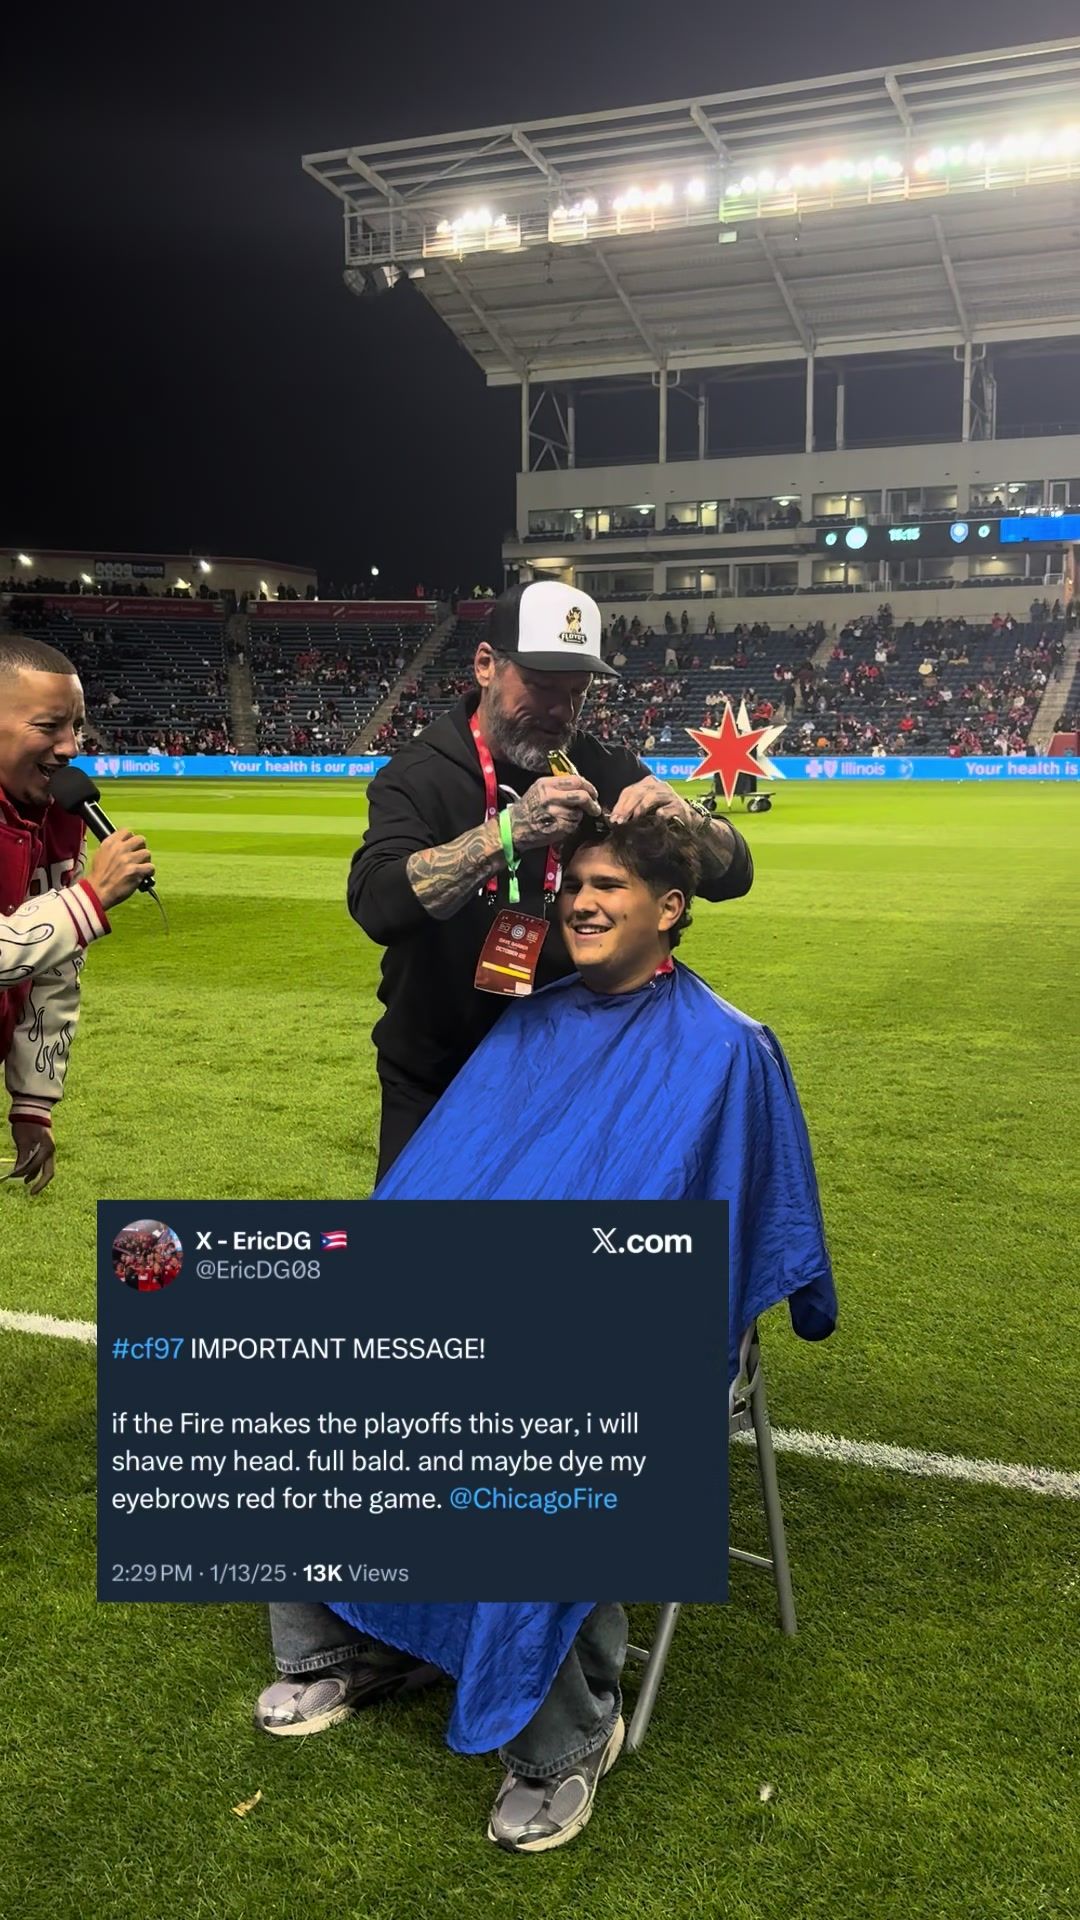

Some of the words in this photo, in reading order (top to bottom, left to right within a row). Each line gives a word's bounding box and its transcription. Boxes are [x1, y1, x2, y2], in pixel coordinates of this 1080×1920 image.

[122, 760, 160, 772] Illinois
[230, 761, 261, 773] Your
[265, 761, 308, 773] health
[311, 761, 321, 773] is
[324, 763, 345, 773] our
[656, 761, 668, 774] is
[841, 761, 885, 776] Illinois
[966, 762, 1002, 775] Your
[1007, 761, 1060, 775] health
[1065, 761, 1079, 775] is
